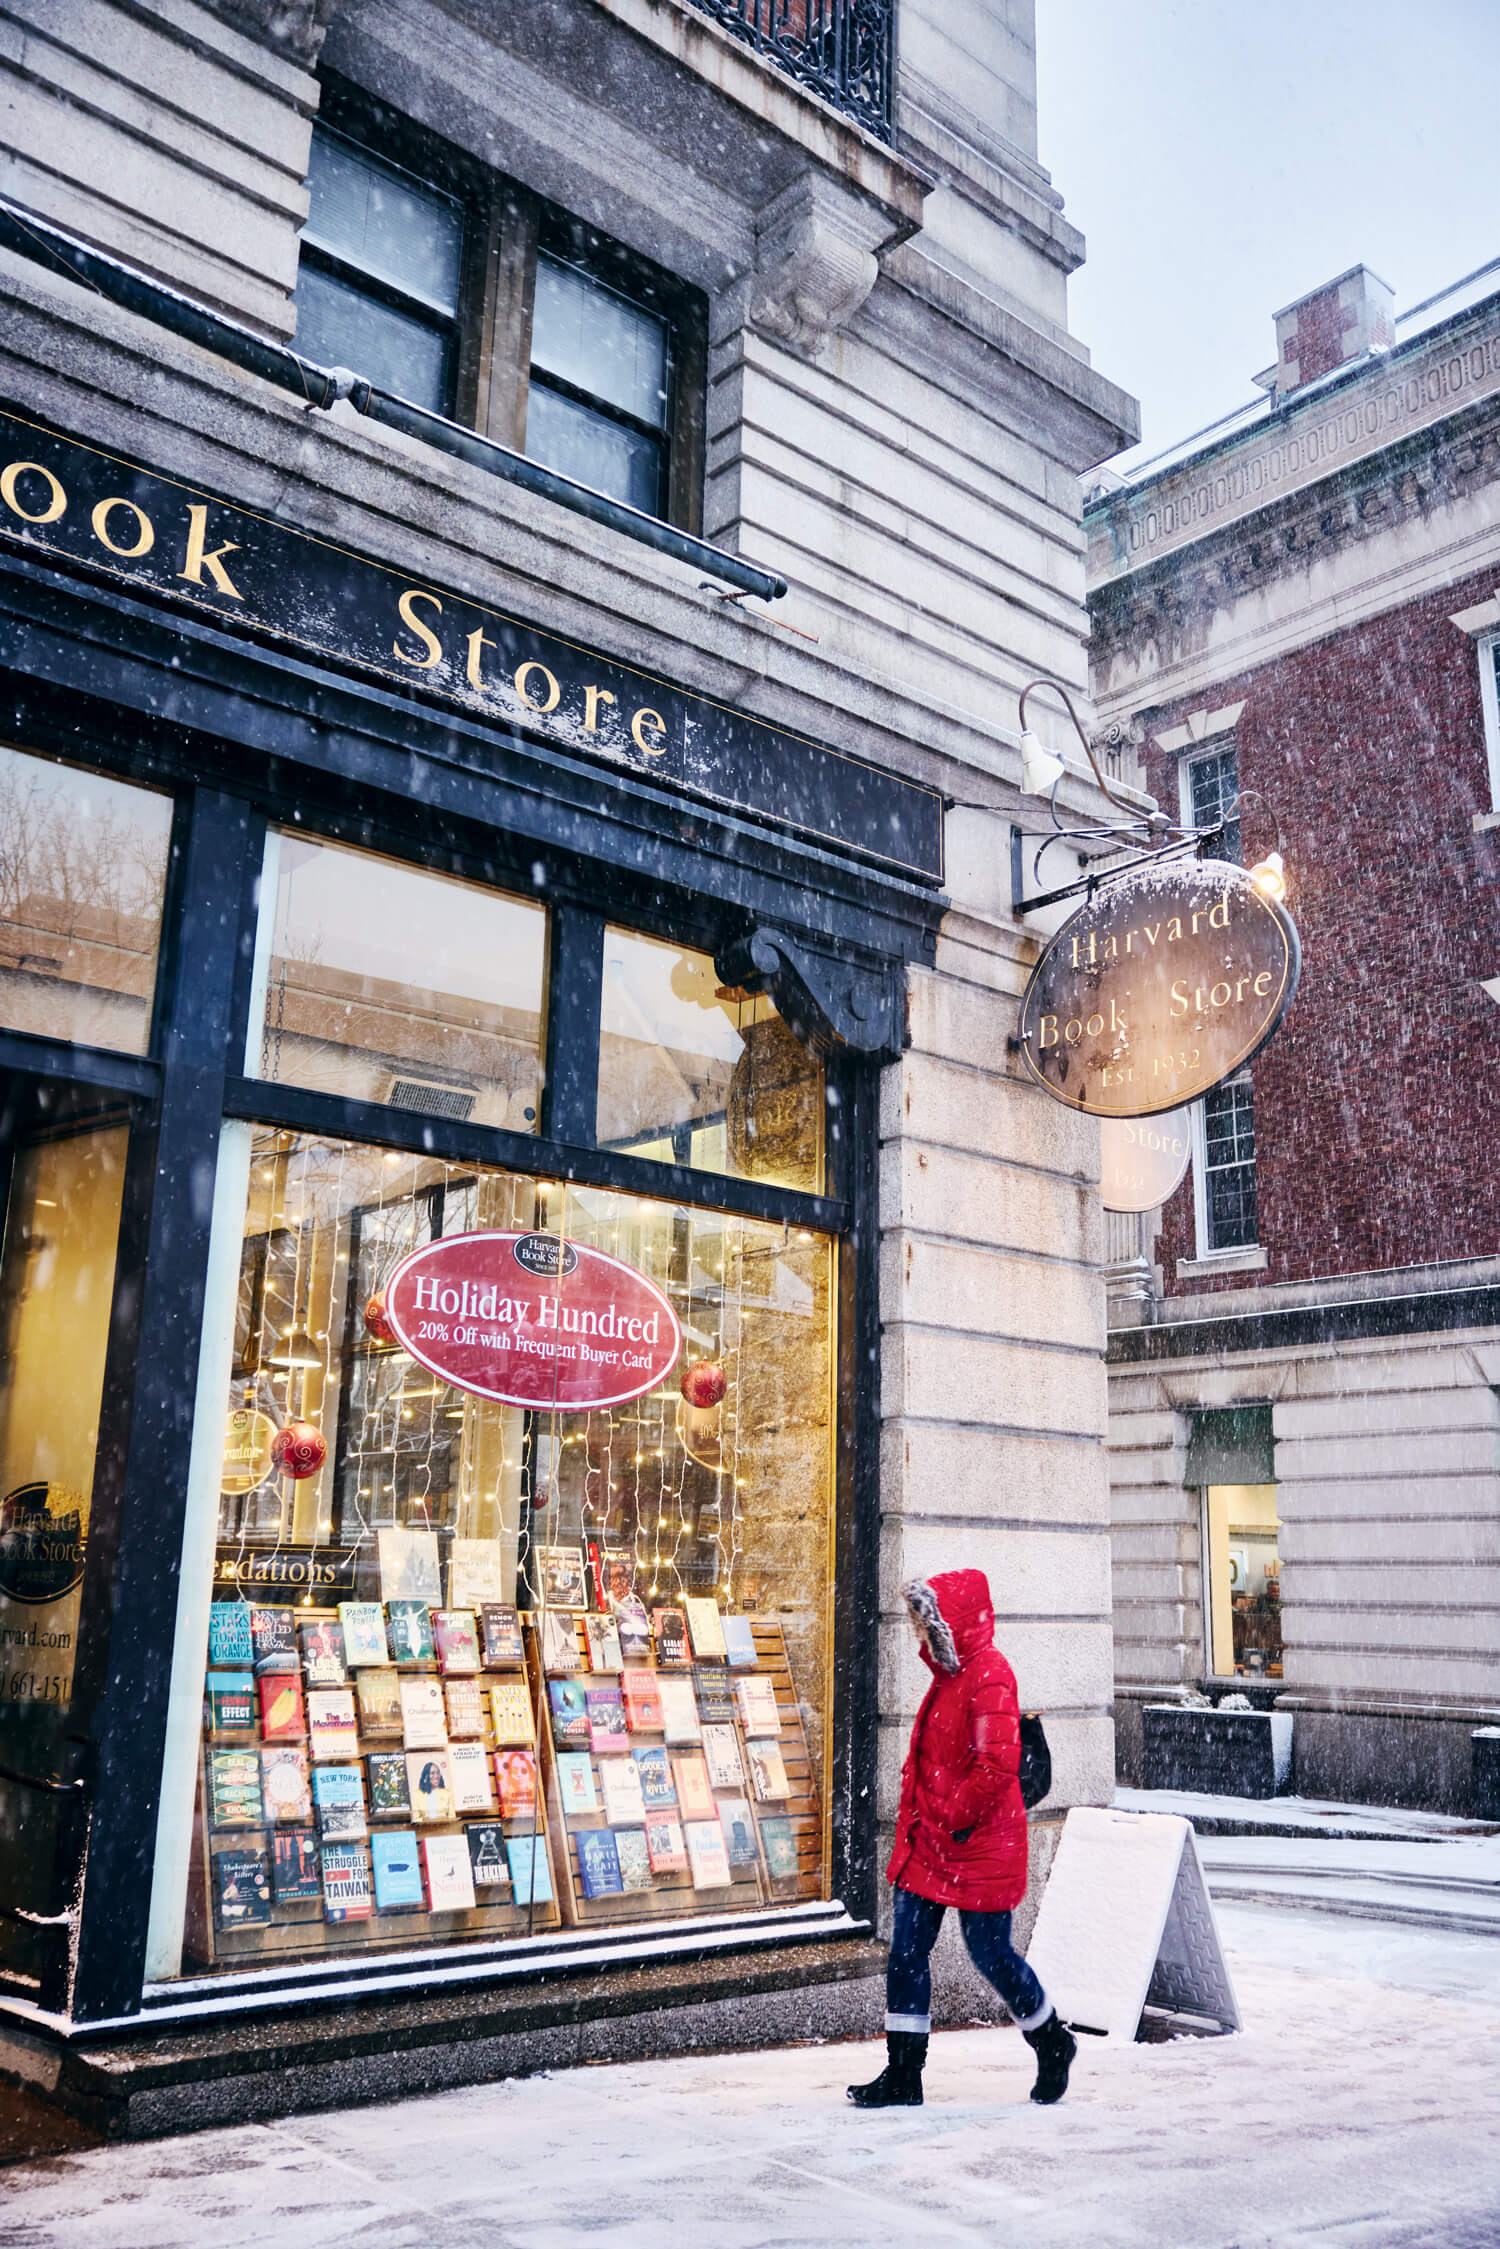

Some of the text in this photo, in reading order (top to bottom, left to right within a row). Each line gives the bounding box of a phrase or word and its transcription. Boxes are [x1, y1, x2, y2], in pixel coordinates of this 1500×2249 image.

[393, 590, 668, 756] Store
[1070, 890, 1231, 969] Harvard
[1038, 970, 1273, 1049] Book Store
[1152, 1049, 1201, 1078] 1932
[1124, 1120, 1183, 1157] Store
[522, 1249, 545, 1262] Book
[413, 1276, 659, 1344] Holiday Hundred
[417, 1321, 653, 1369] 20% Off with Frequent Buyer Card
[40, 1536, 81, 1562] Store
[212, 1614, 249, 1628] STARS
[214, 1644, 252, 1658] ORANGE
[489, 1647, 520, 1655] LARSON
[222, 1706, 250, 1718] EFFECT
[325, 1712, 341, 1721] The
[312, 1719, 355, 1728] Movement
[320, 1772, 358, 1785] NEW YORK
[646, 1783, 669, 1796] RIVER
[323, 1847, 341, 1857] THE
[223, 1863, 263, 1872] Shakespeare's
[323, 1856, 368, 1870] STRUGGLE
[352, 1868, 369, 1880] FOR
[325, 1881, 370, 1898] TAIWAN
